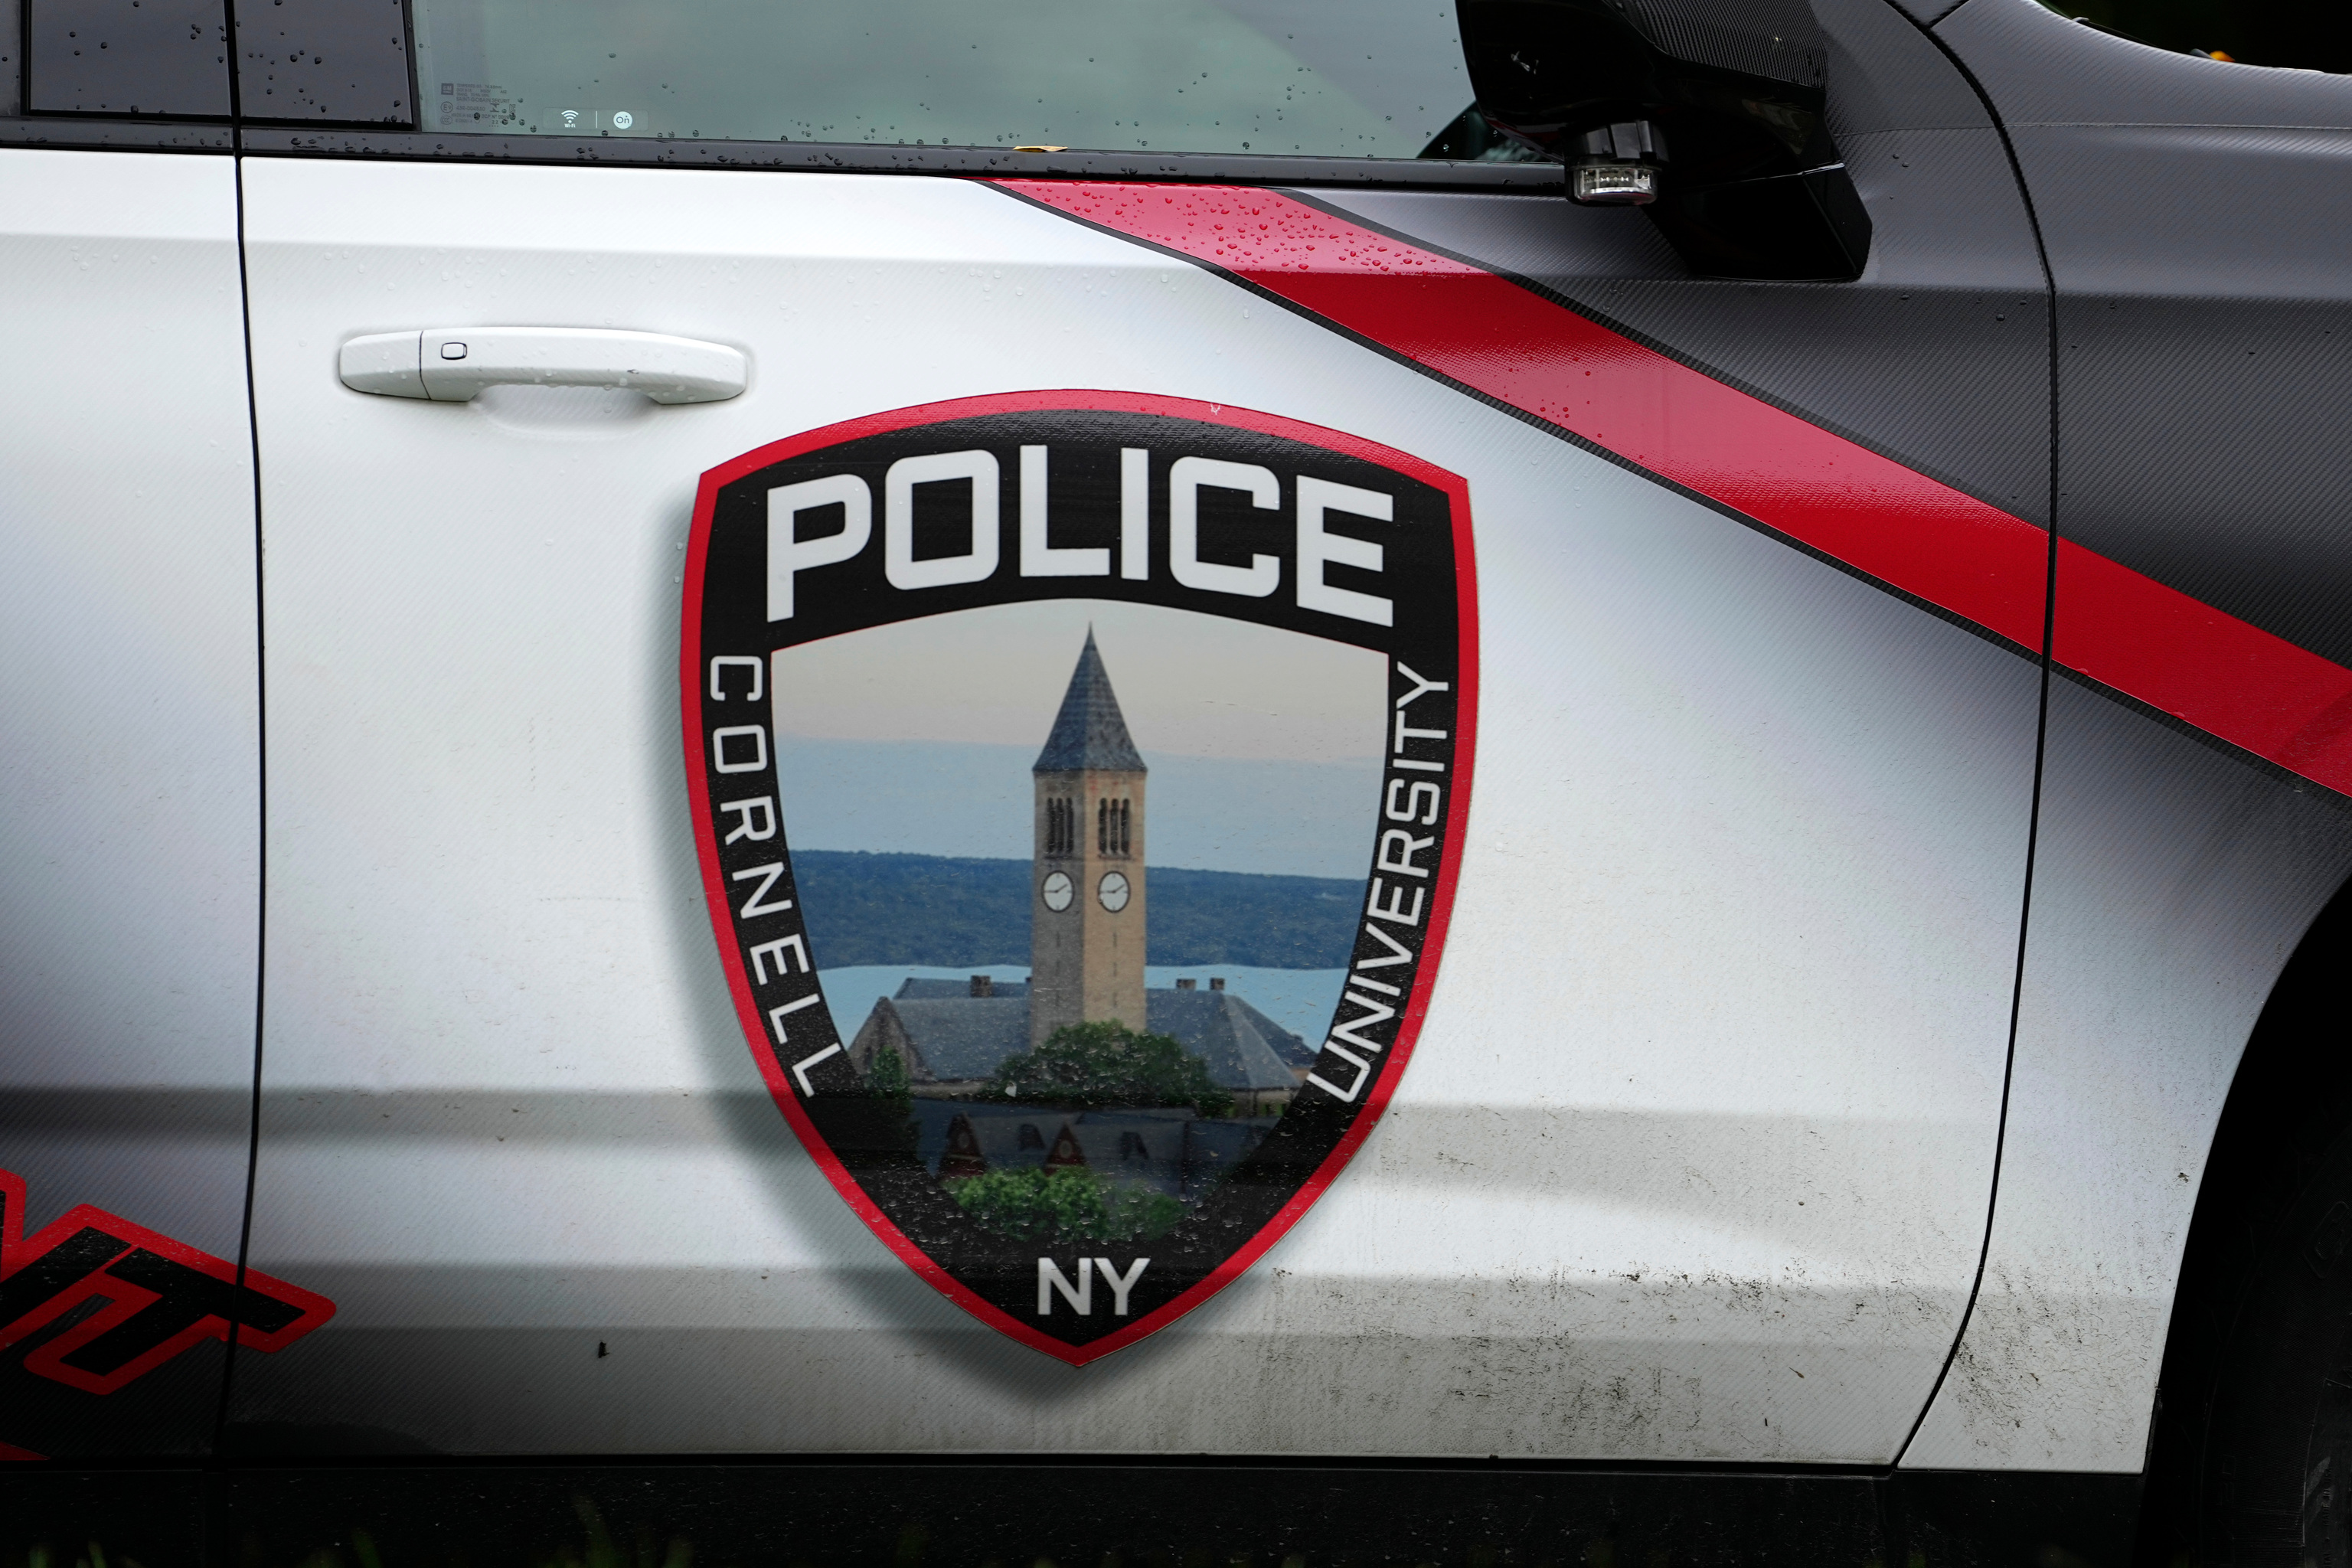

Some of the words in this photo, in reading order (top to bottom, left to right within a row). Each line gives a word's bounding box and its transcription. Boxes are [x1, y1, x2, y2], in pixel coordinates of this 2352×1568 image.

[766, 444, 1393, 628] POLICE
[709, 655, 842, 1098] CORNELL
[1306, 661, 1449, 1103] UNIVERSITY
[1037, 1256, 1151, 1316] NY
